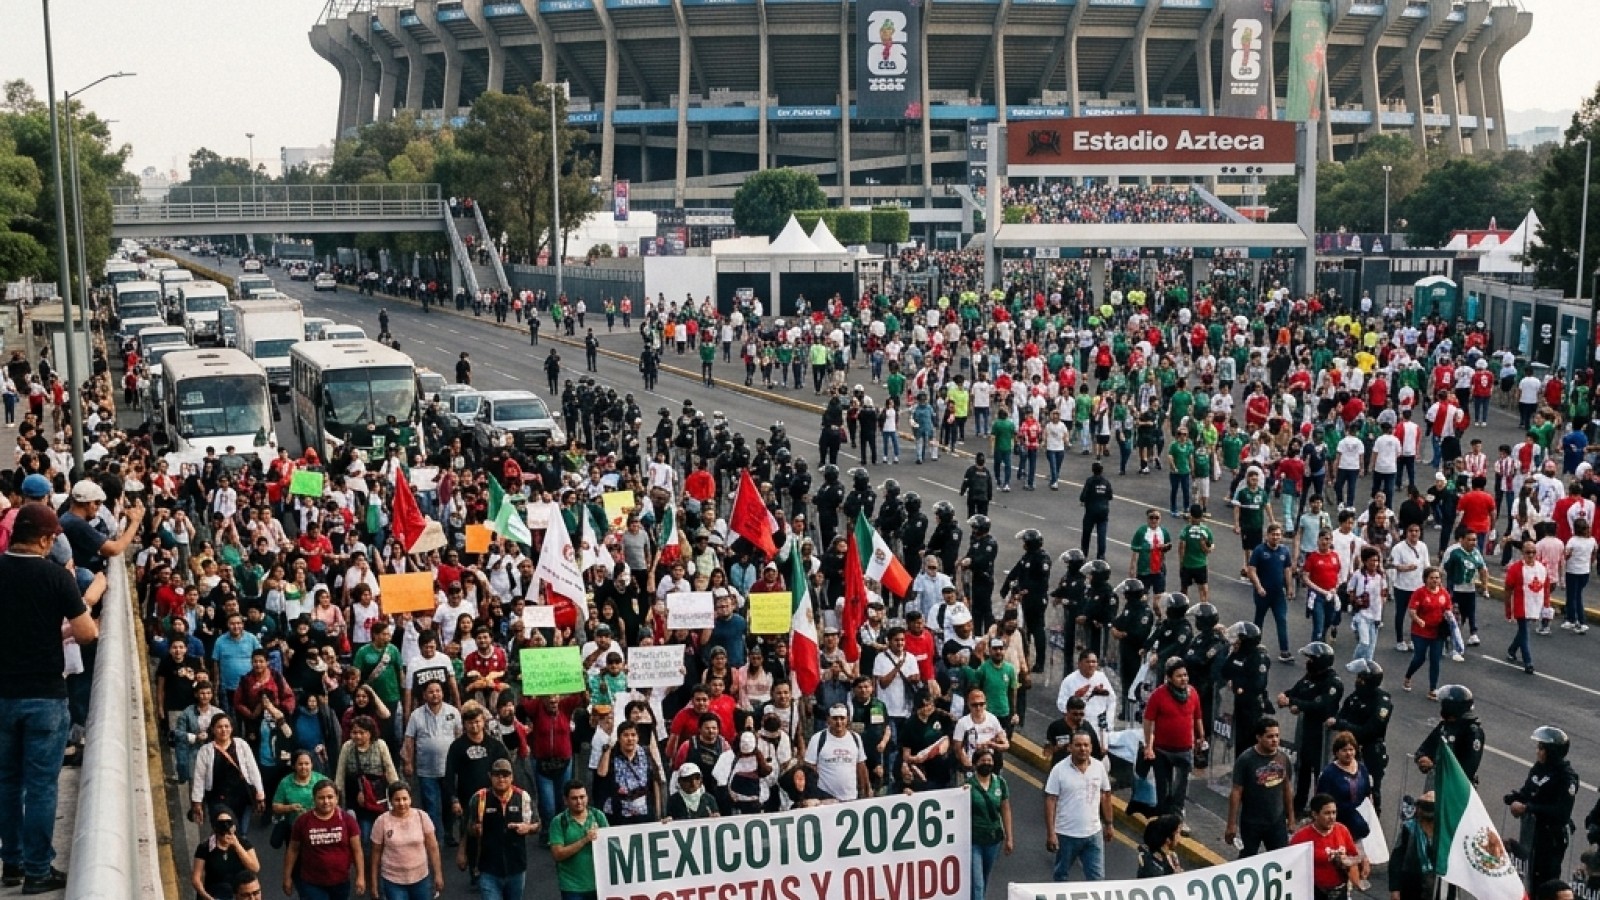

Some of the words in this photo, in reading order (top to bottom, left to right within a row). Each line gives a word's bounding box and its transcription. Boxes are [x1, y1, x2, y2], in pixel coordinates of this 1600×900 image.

[1072, 130, 1168, 151] Estadio
[1175, 130, 1265, 151] Azteca
[607, 813, 823, 886] MEXICOTO
[835, 798, 955, 858] 2026:
[810, 870, 832, 900] Y
[843, 854, 960, 900] OLVIDO
